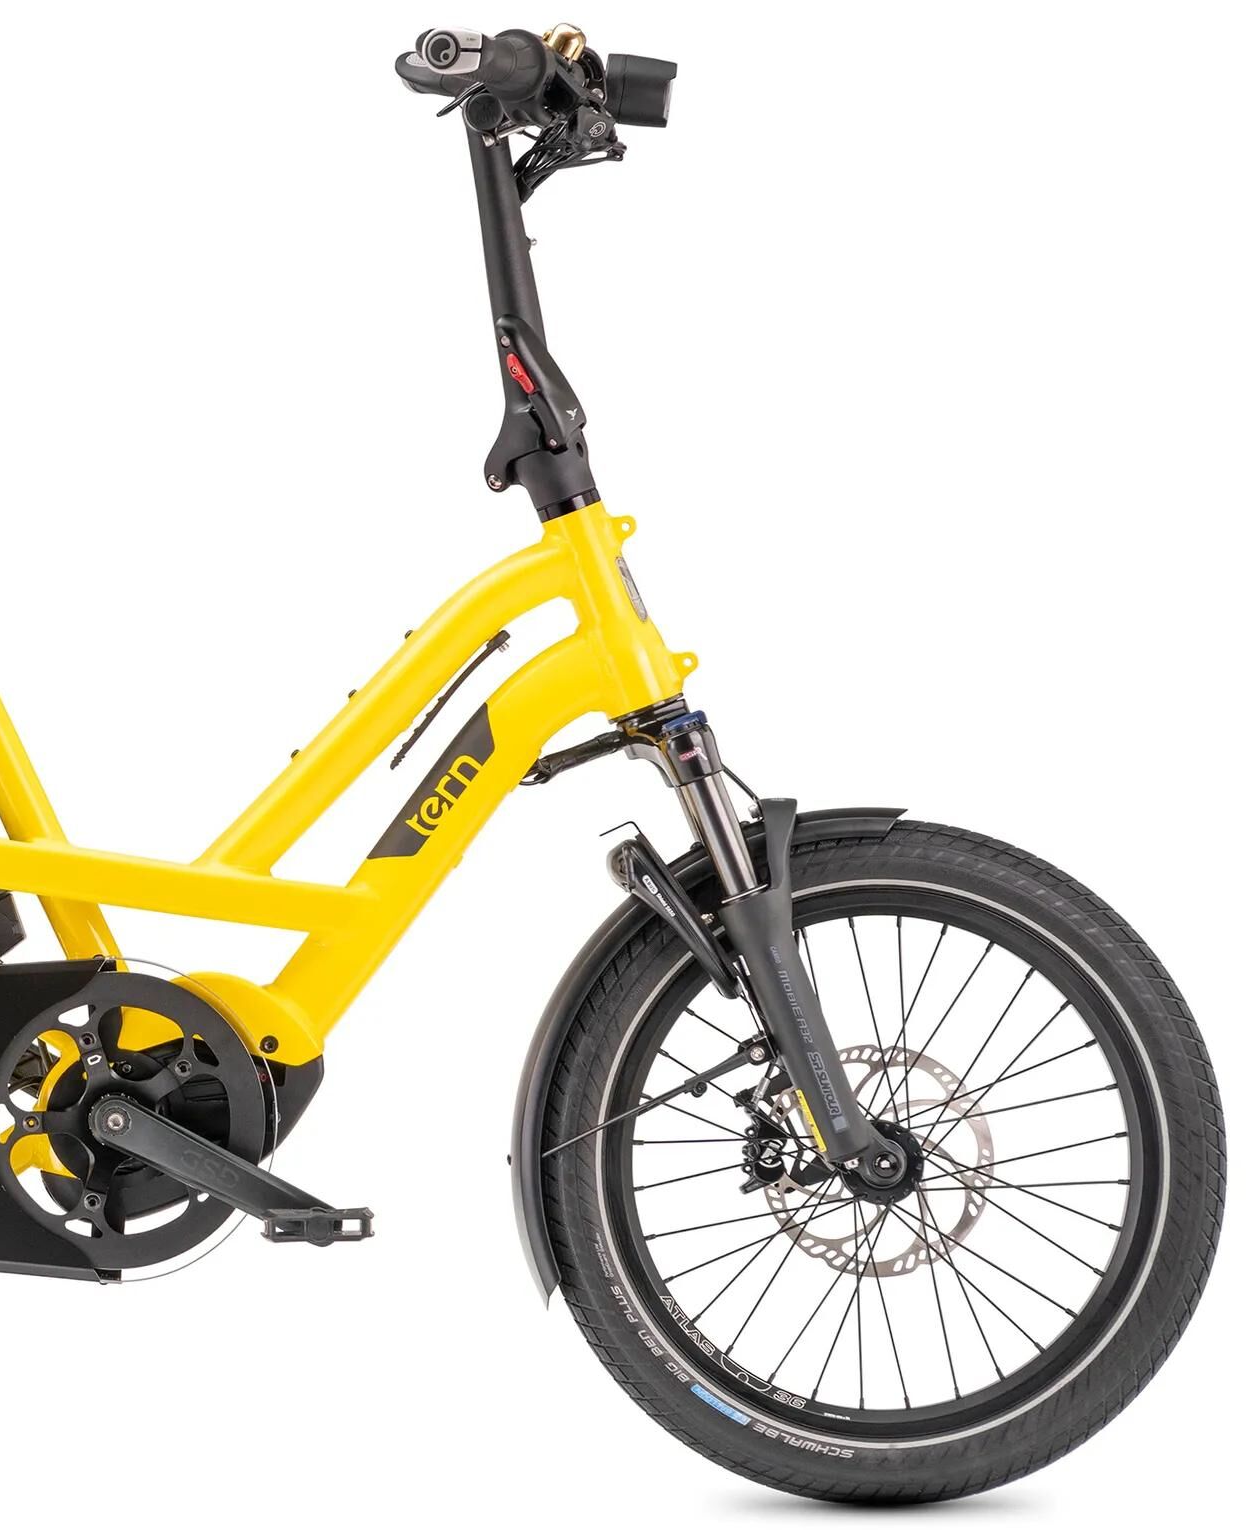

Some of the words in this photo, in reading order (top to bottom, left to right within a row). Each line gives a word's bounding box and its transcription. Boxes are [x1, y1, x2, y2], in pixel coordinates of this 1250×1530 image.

[405, 754, 483, 837] tern
[610, 1285, 639, 1323] PLUS
[638, 1329, 664, 1357] BEN
[660, 1295, 716, 1356] ATLAS
[773, 1389, 807, 1410] 36
[664, 1361, 690, 1383] BIG
[753, 1422, 855, 1459] SCHWALBE
